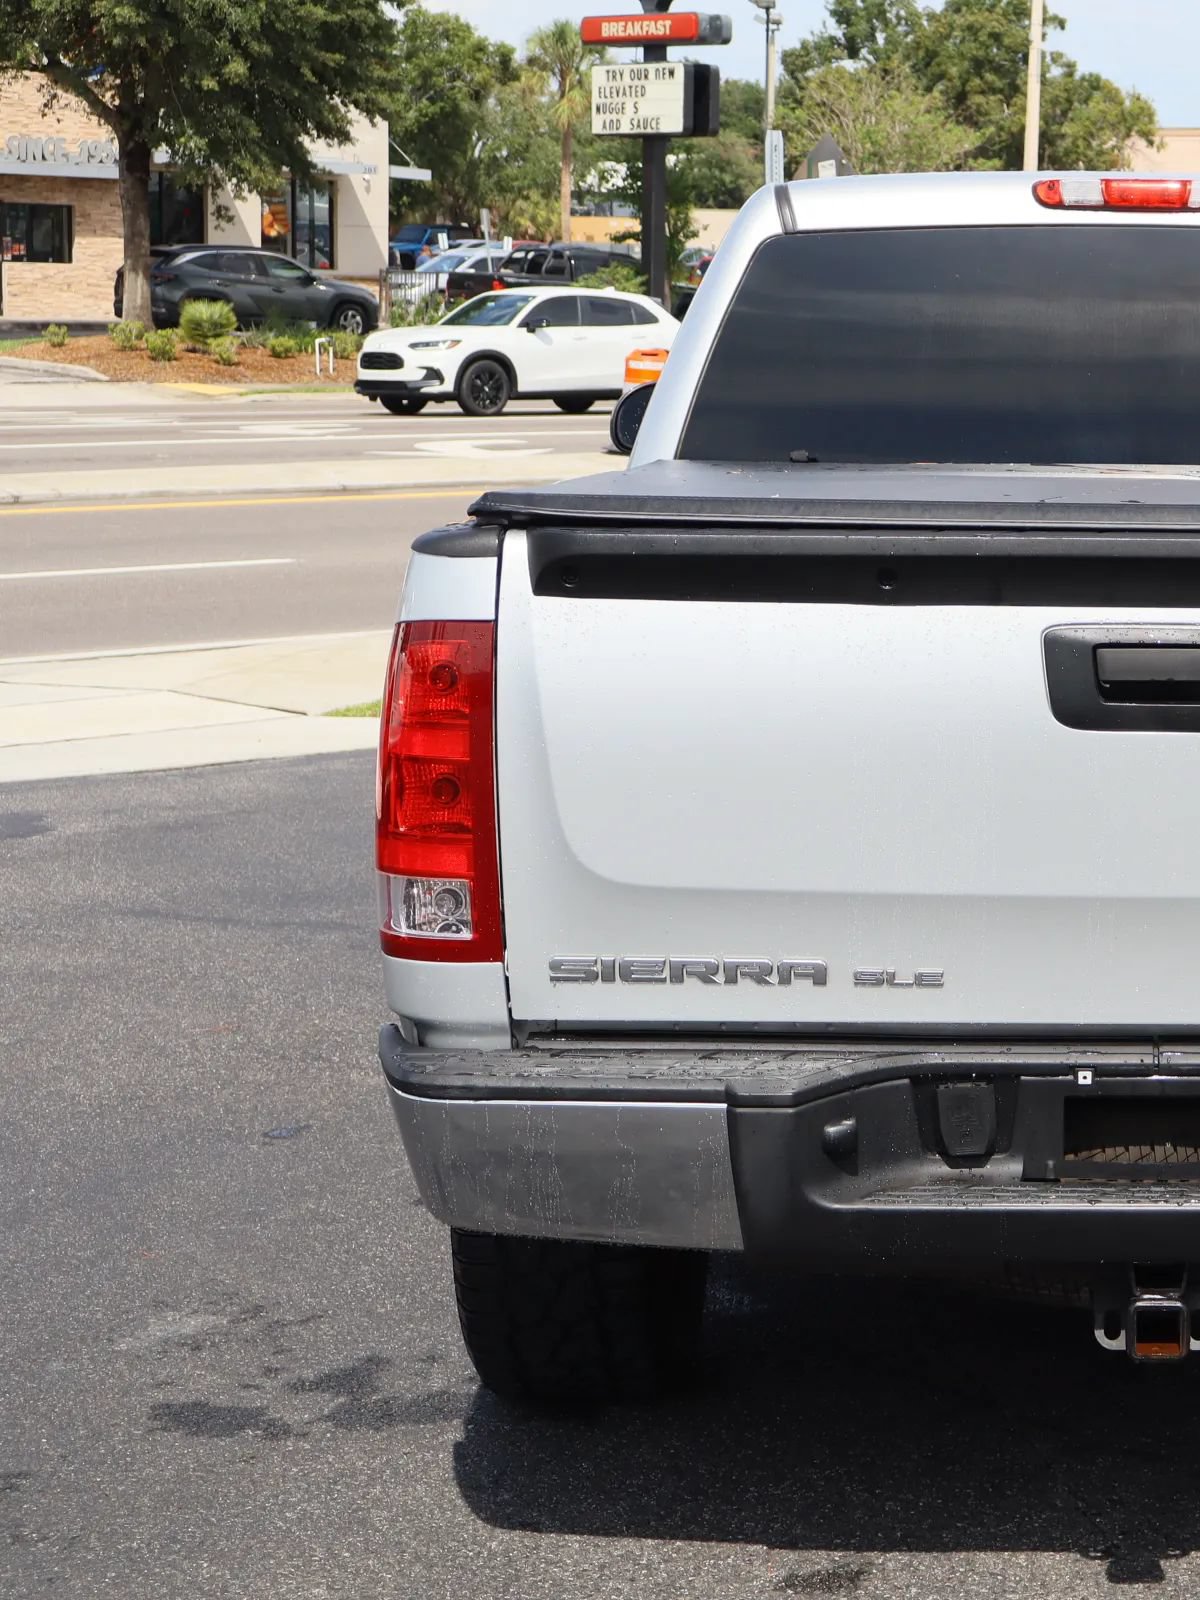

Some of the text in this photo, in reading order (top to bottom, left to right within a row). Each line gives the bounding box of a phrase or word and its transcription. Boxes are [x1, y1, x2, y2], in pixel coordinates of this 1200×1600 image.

[601, 20, 672, 37] BREAKFAST
[605, 66, 675, 83] TRY OUR NEW
[598, 86, 646, 99] ELEVATED
[602, 117, 661, 131] AND SAUCE
[6, 135, 66, 161] SINCE
[549, 956, 944, 988] SIERRA SLE
